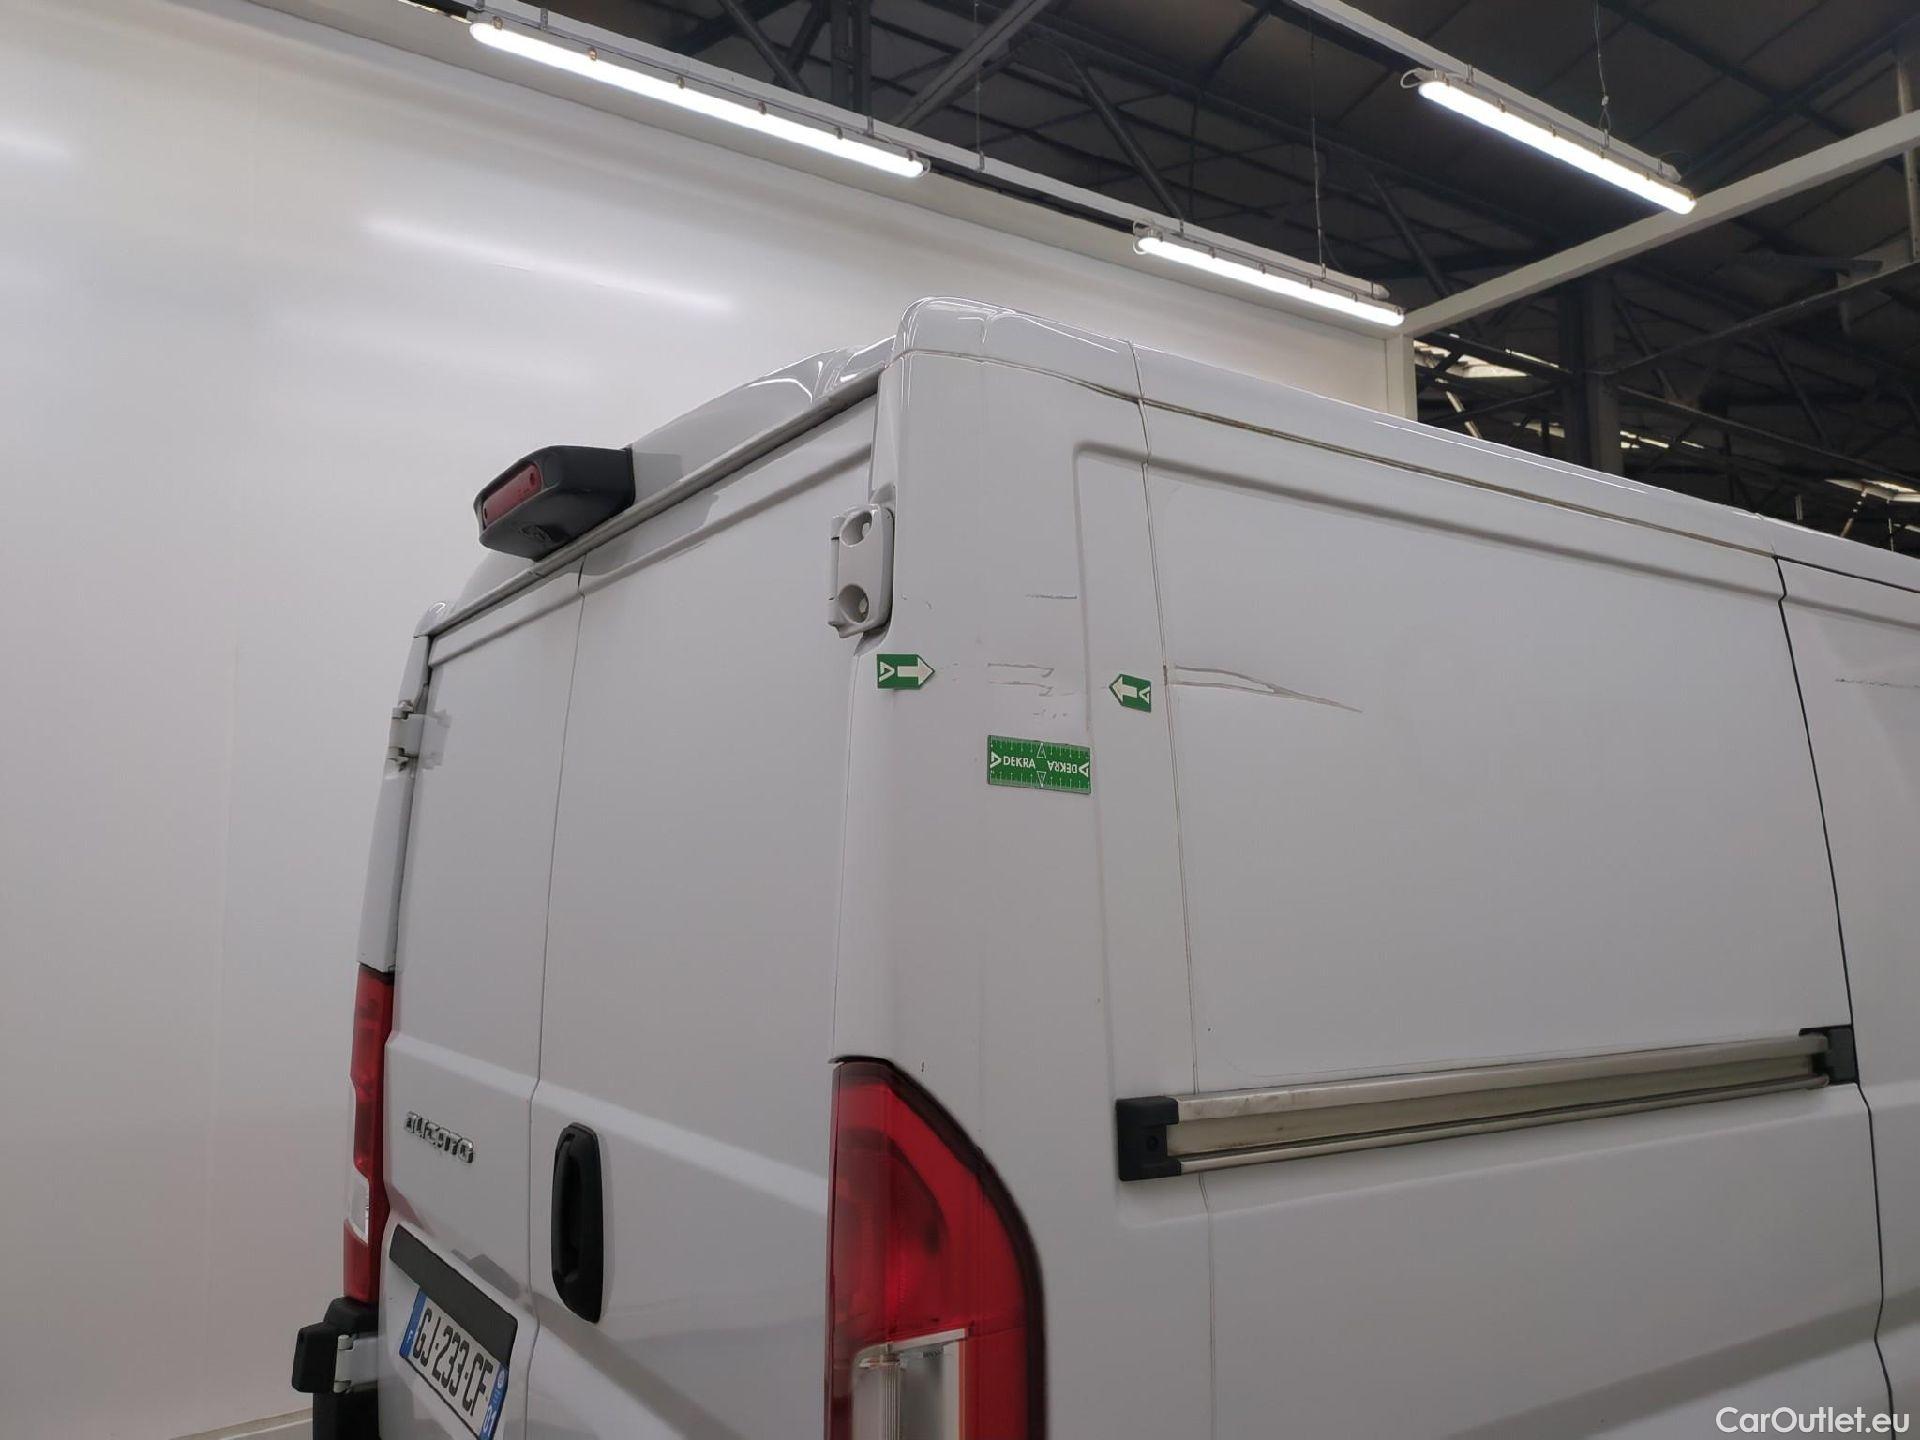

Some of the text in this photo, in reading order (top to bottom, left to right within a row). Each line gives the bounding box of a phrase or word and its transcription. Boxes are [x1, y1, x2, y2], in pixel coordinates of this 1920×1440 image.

[1003, 756, 1036, 769] DEKRA
[1047, 760, 1077, 773] DEKRA
[412, 1308, 494, 1417] GJ-233-CF
